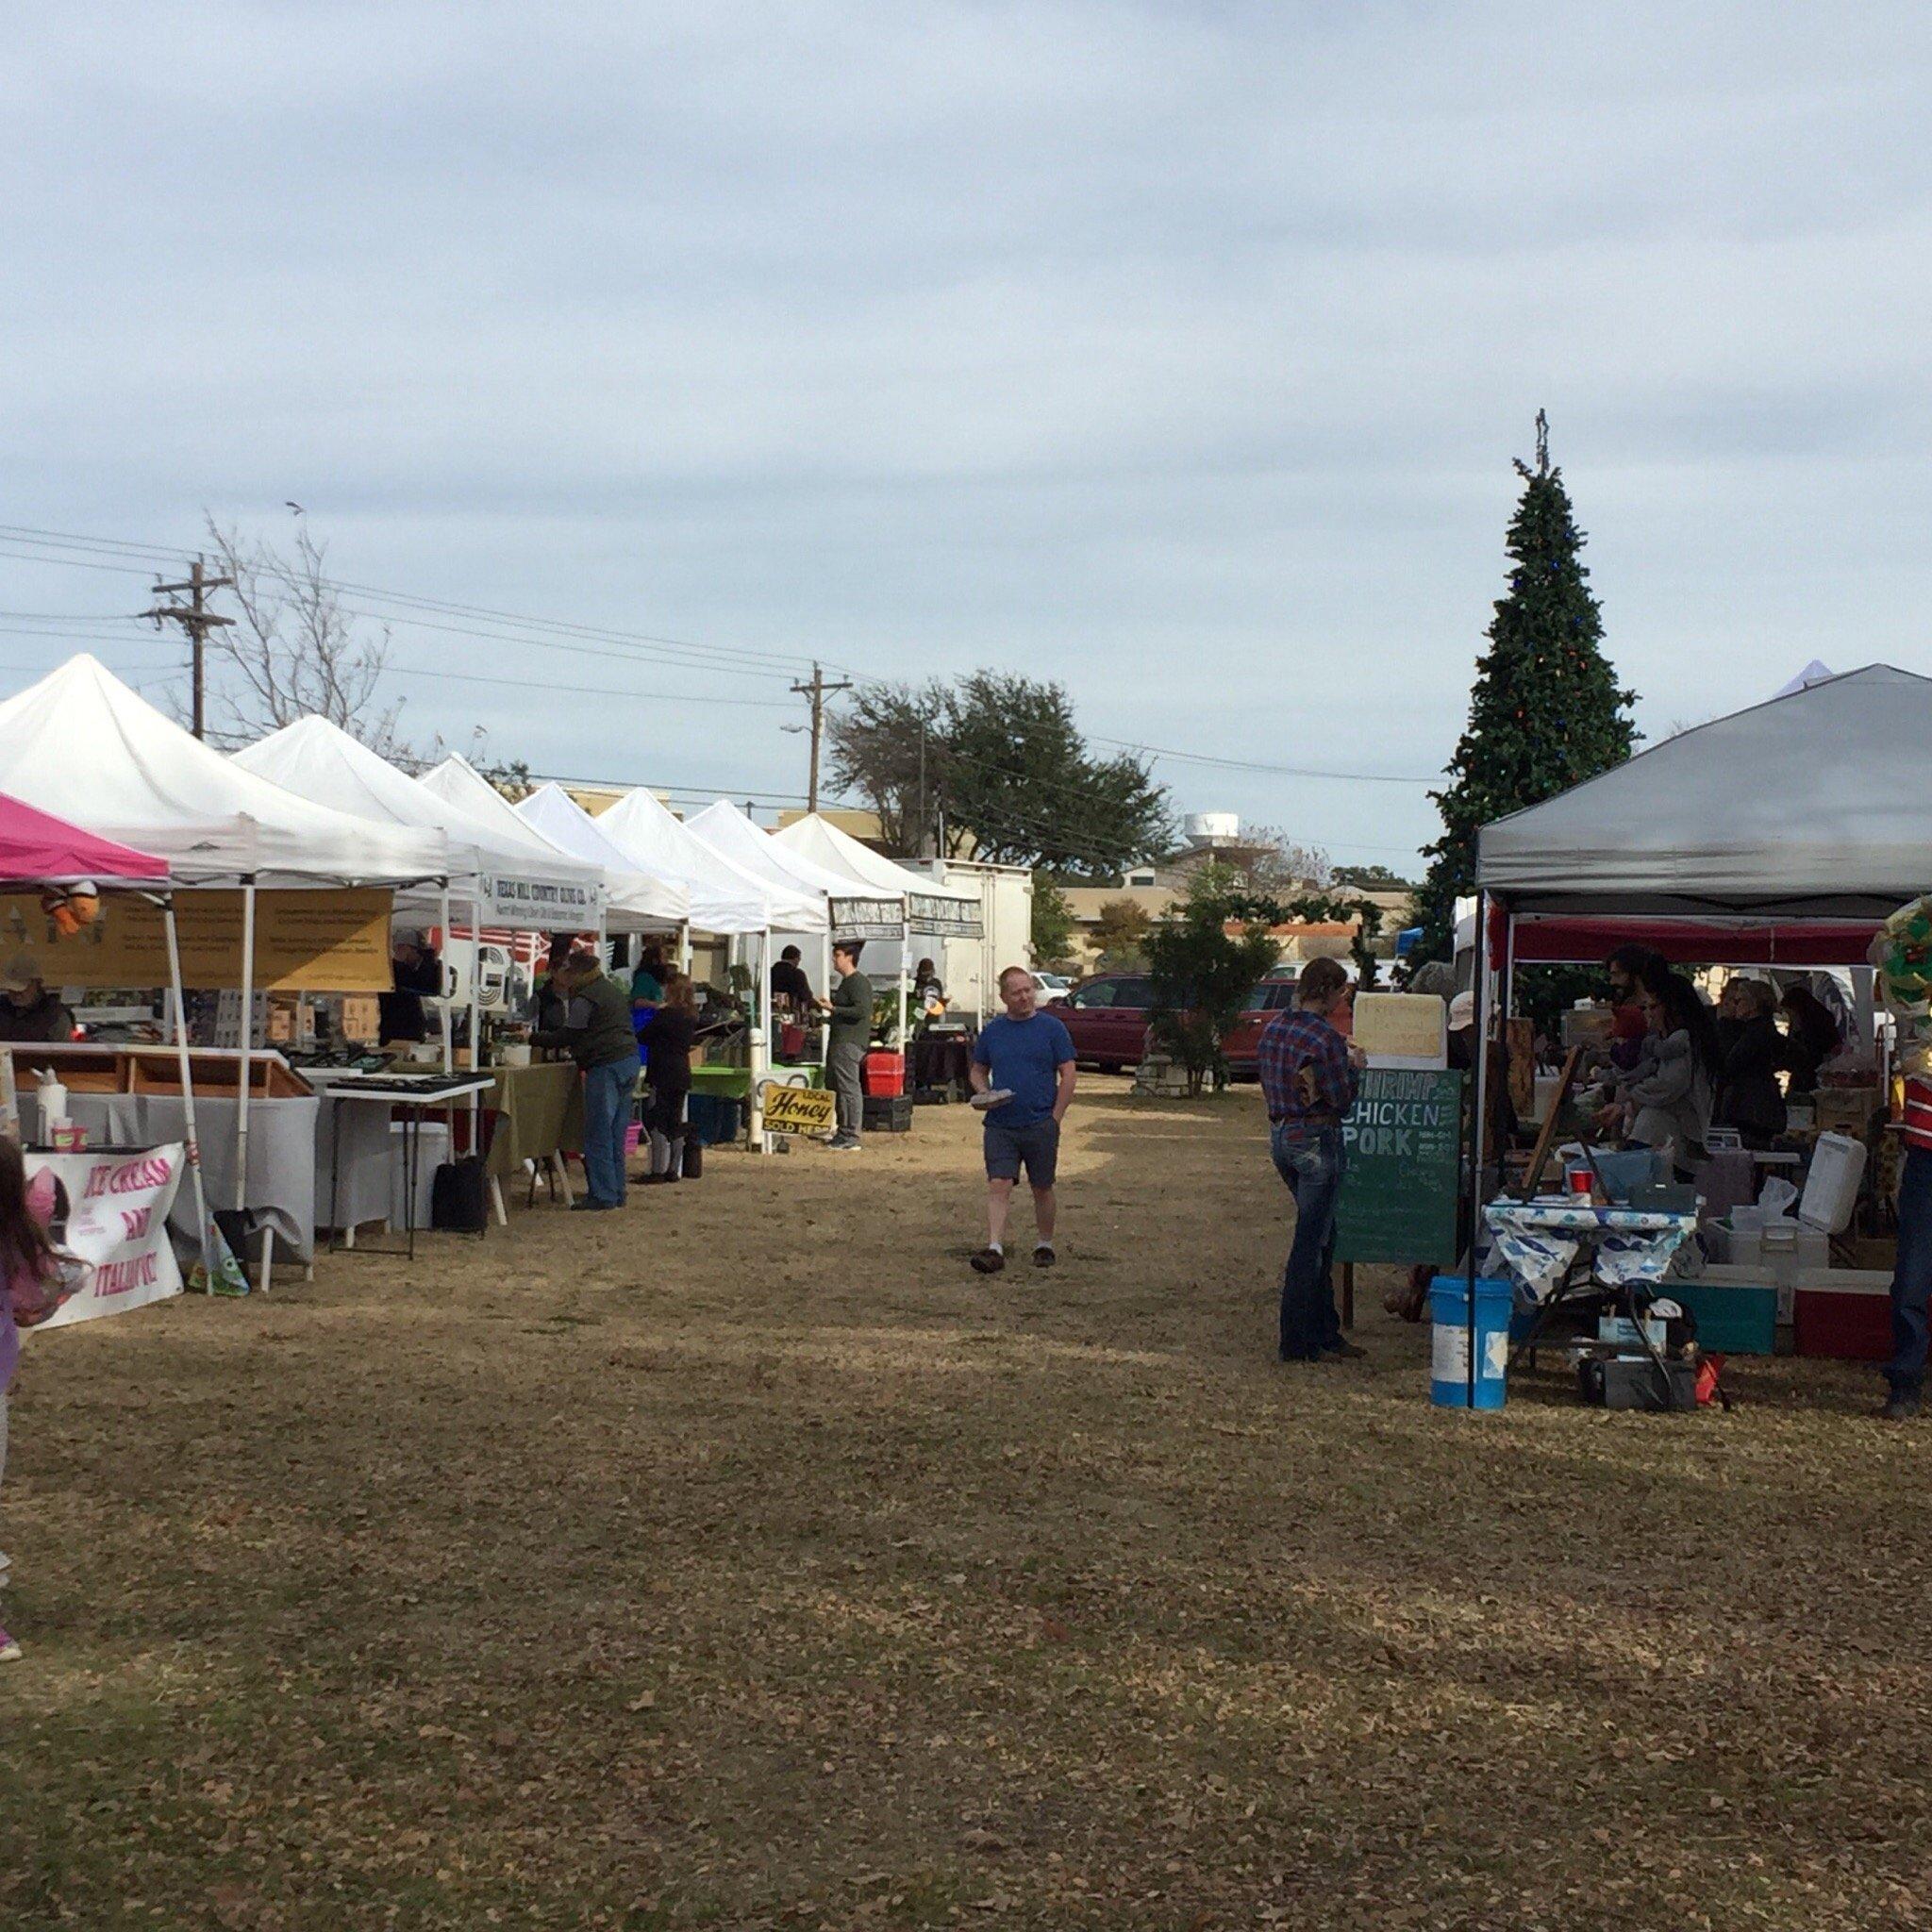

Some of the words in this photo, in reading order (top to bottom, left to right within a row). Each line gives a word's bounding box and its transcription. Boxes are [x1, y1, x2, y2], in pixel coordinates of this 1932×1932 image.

[766, 1091, 832, 1123] Honey
[803, 1091, 831, 1102] LOCAL
[764, 1120, 795, 1133] SOLD
[1341, 1126, 1413, 1157] PORK
[109, 1158, 172, 1195] CREAM
